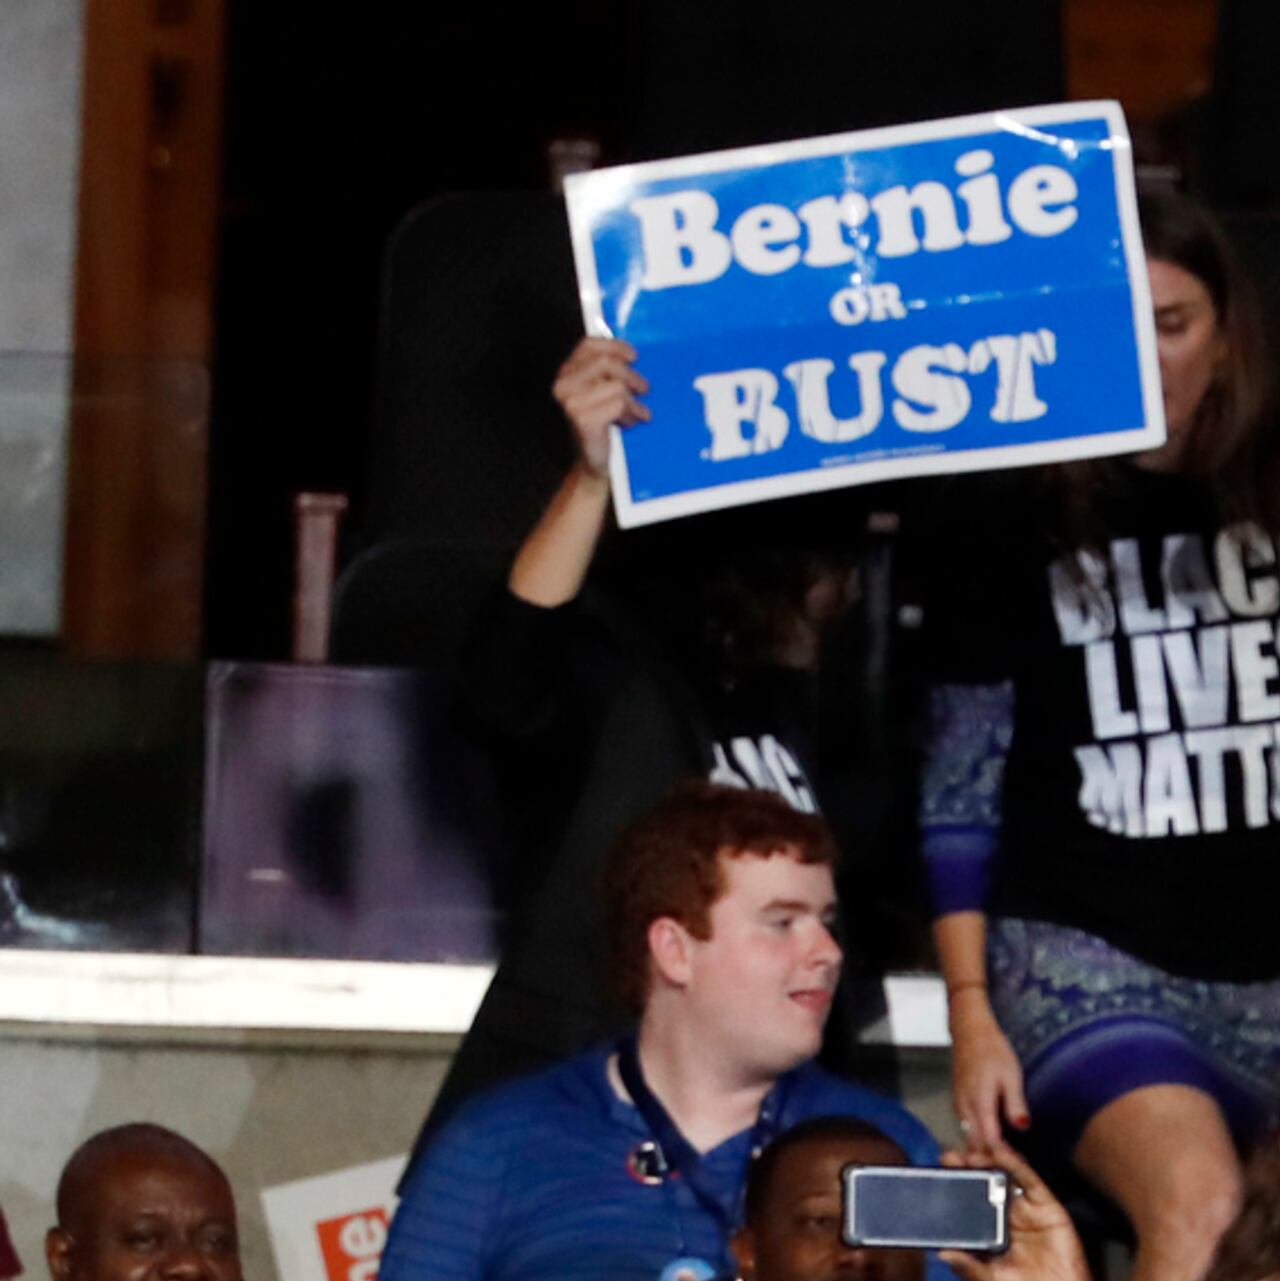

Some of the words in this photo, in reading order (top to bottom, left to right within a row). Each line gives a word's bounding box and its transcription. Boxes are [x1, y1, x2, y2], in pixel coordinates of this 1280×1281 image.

[631, 148, 1079, 291] Bernie
[829, 282, 906, 326] OR
[693, 328, 1057, 462] BUST
